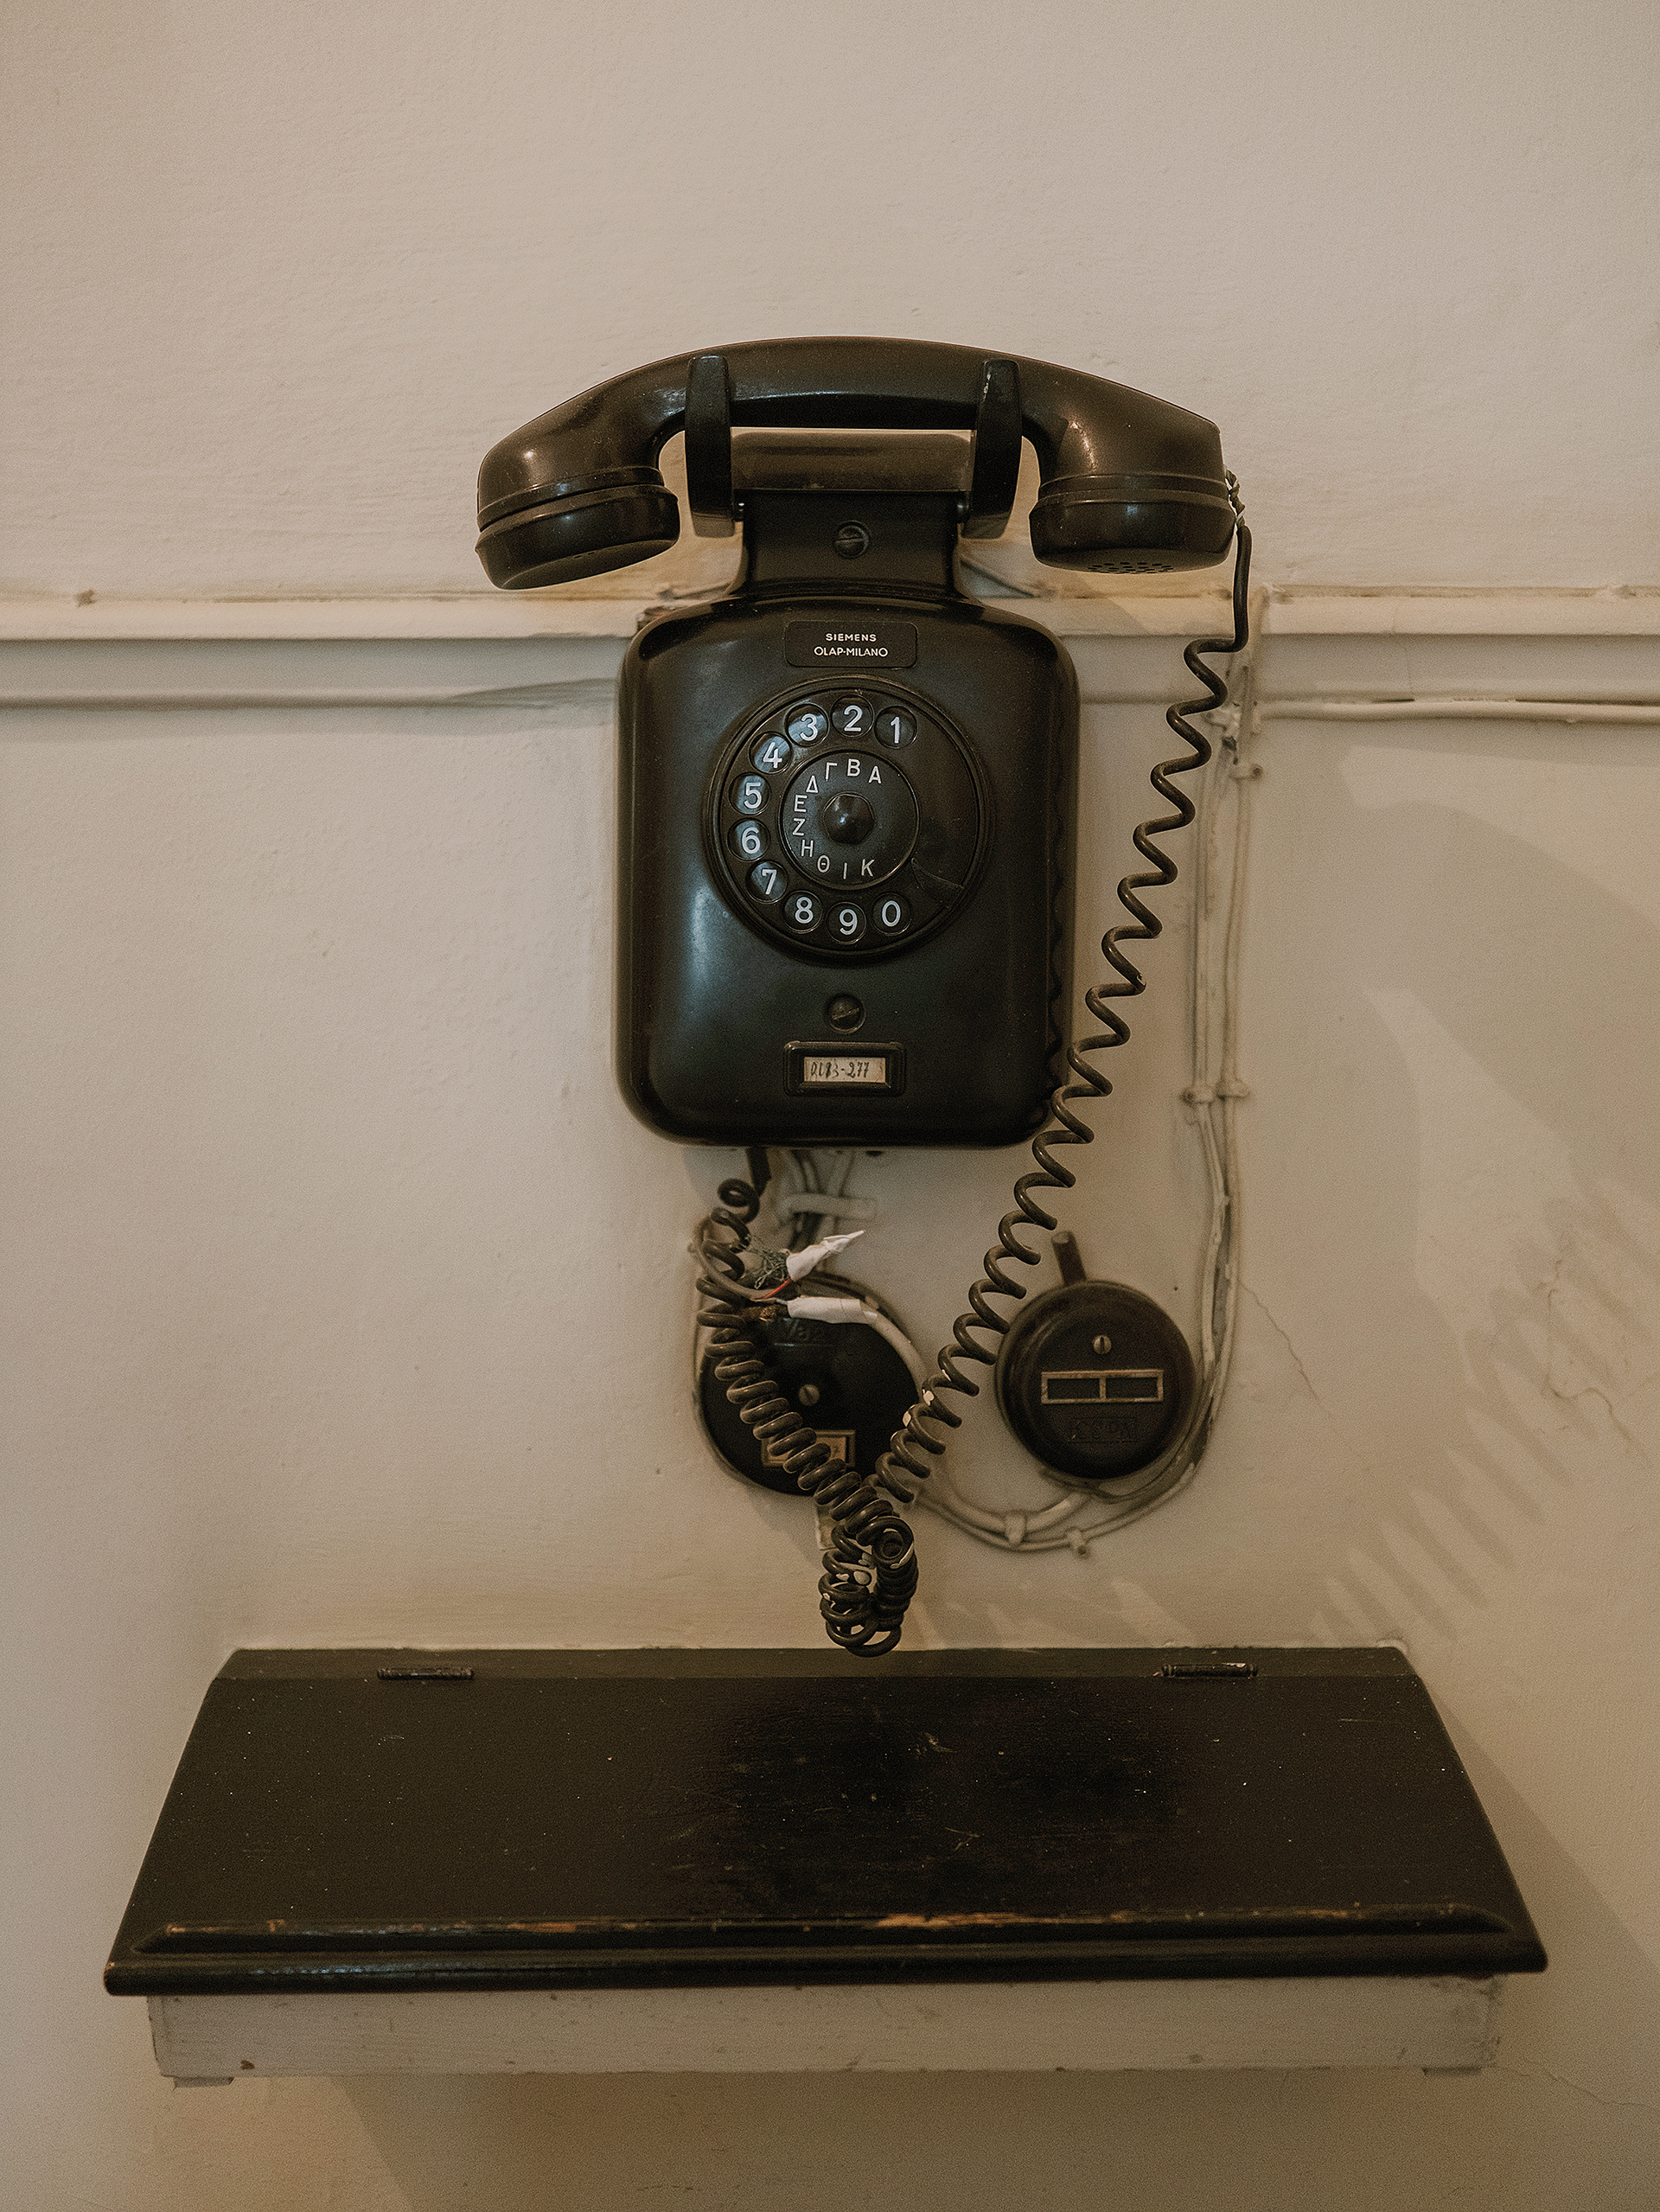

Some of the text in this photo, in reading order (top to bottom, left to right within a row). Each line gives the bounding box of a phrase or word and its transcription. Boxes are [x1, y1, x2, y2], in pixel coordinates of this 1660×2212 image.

[826, 633, 877, 642] SIEMENS
[825, 762, 838, 782] Γ
[806, 775, 819, 794] Δ
[741, 704, 901, 936] 1 2 3 4 5 6 7 8 9 0
[817, 854, 830, 873] Θ
